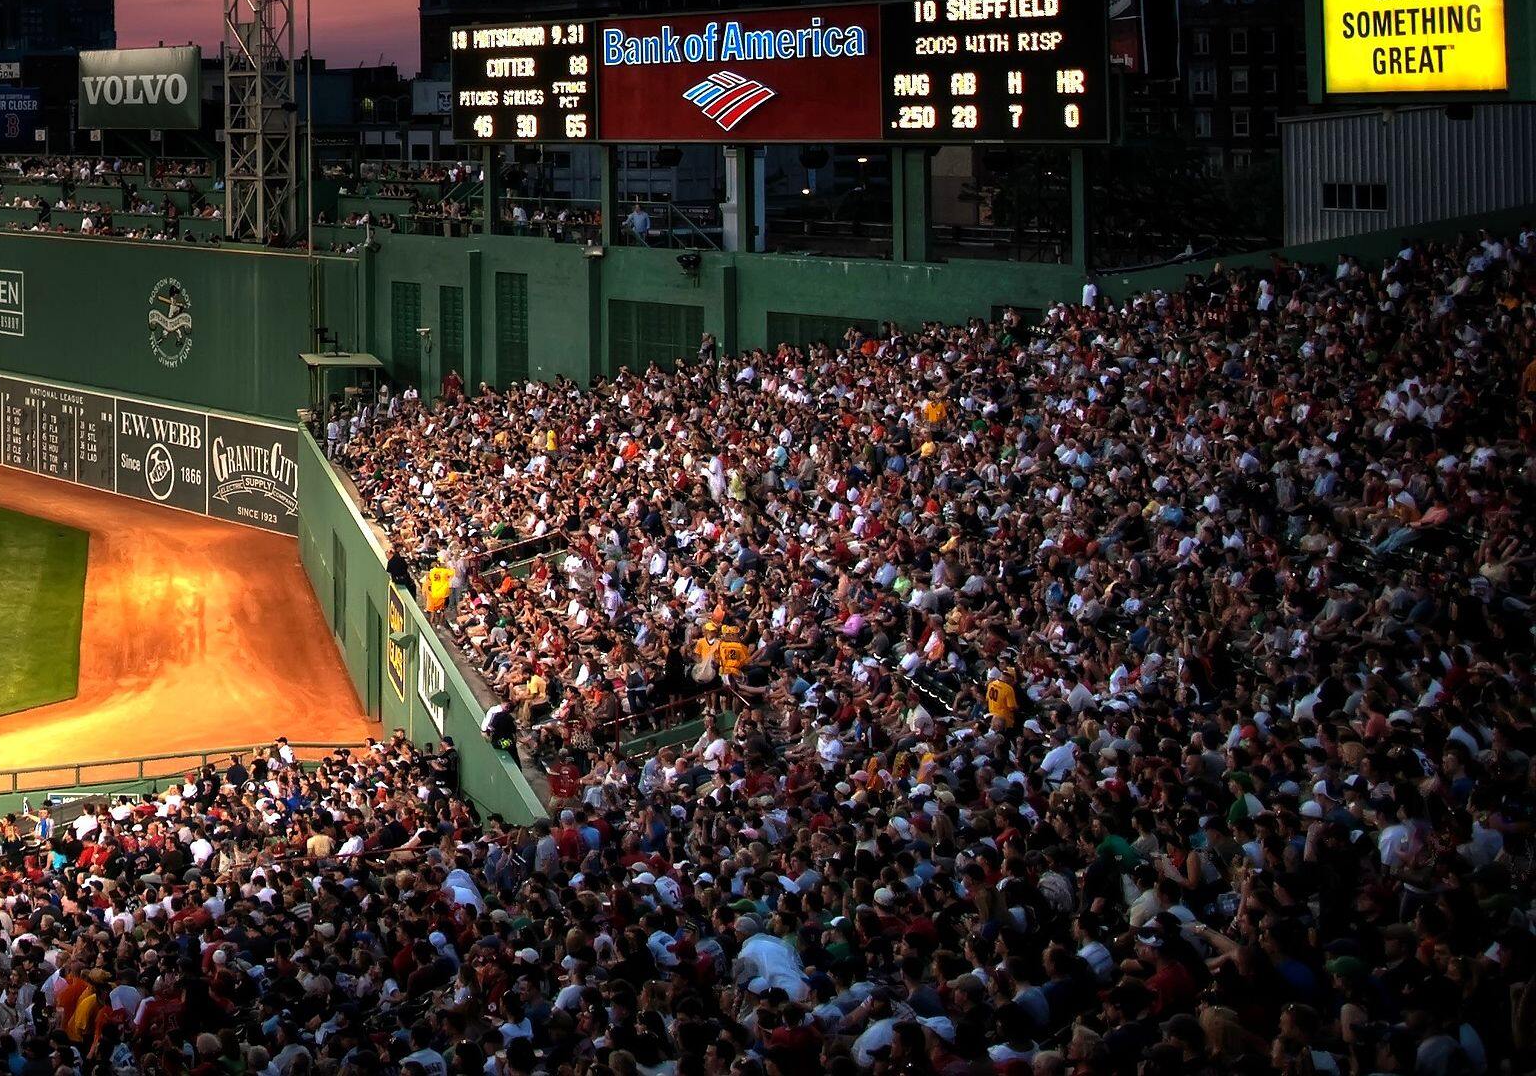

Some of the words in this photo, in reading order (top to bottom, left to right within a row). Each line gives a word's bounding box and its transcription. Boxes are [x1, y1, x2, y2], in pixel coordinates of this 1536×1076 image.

[915, 0, 936, 23] 10
[1342, 4, 1482, 38] SOMETHING
[472, 26, 545, 49] MATSUZAKA
[603, 25, 683, 66] Bank
[684, 21, 718, 63] of
[721, 17, 865, 62] America
[915, 35, 957, 55] 2009
[966, 33, 1009, 54] WITH
[1018, 31, 1063, 53] RISP
[486, 57, 535, 78] CUTTER
[82, 73, 188, 105] VOLVO
[894, 74, 930, 96] AVG
[951, 72, 976, 96] AB
[1008, 71, 1022, 94] H
[1056, 69, 1085, 94] HR
[8, 100, 38, 111] CLOSER
[459, 89, 499, 107] PITCHES
[503, 89, 544, 106] STRIKES
[559, 96, 580, 109] PCT
[472, 114, 493, 138] 46
[516, 114, 537, 138] 30
[565, 114, 587, 138] 65
[891, 105, 935, 128] .250
[951, 105, 977, 128] 28
[1008, 104, 1023, 128] 7
[1065, 104, 1079, 128] 0
[148, 278, 168, 305] BOSTON
[30, 387, 58, 400] NATIONAL
[59, 392, 84, 405] LEAGUE
[49, 424, 58, 433] FLA
[49, 434, 58, 444] TEX
[87, 433, 96, 442] STL
[88, 423, 96, 432] KC
[121, 411, 150, 439] F.W.
[151, 417, 202, 450] WEBB
[48, 444, 59, 454] HOU
[87, 453, 98, 463] LAD
[212, 435, 270, 482] GRANITE
[121, 452, 141, 472] Since
[180, 467, 202, 485] 1866
[220, 482, 243, 493] ELECTRIC
[245, 477, 272, 491] SUPPLY
[273, 490, 295, 507] COMPANY
[237, 506, 259, 519] SINCE
[261, 512, 278, 524] 1923
